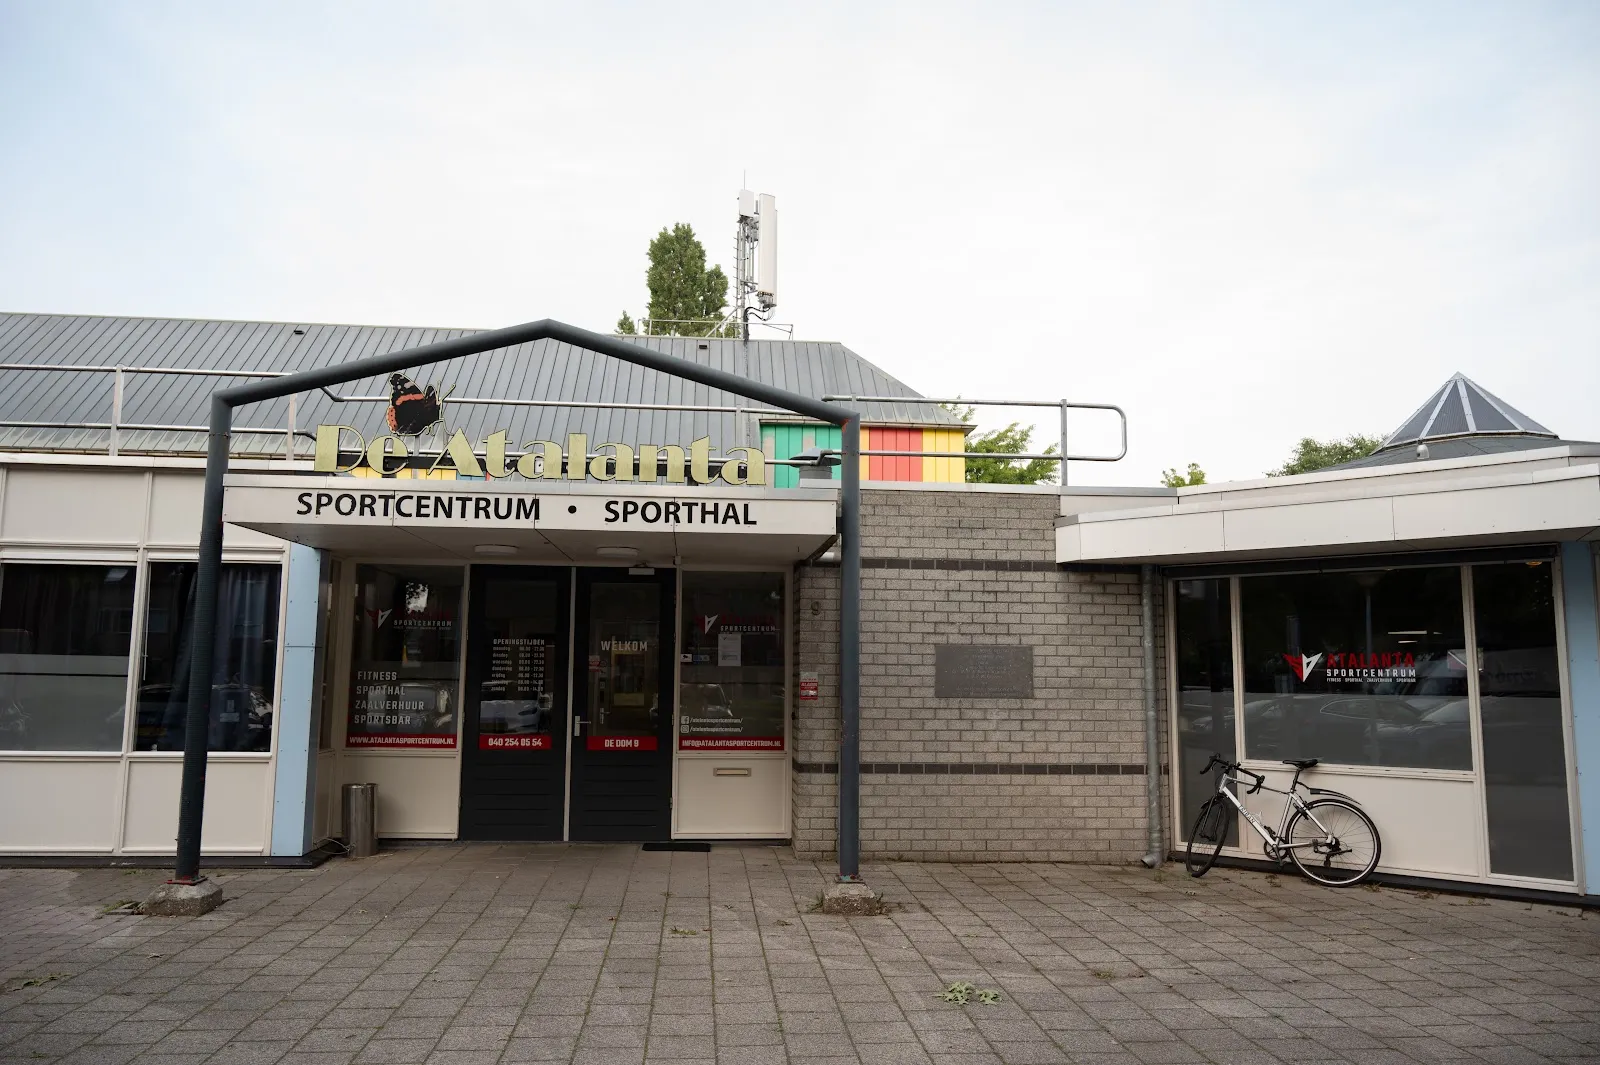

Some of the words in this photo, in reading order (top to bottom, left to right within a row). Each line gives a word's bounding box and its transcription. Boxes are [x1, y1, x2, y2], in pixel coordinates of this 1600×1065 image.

[313, 423, 409, 475] De
[427, 427, 767, 486] Atalanta
[296, 492, 541, 520] SPORTCENTRUM
[604, 499, 758, 525] SPORTHAL
[811, 601, 820, 616] 9
[393, 619, 452, 627] SPORTCENTRUM
[600, 640, 648, 651] WELKOM
[1326, 652, 1416, 668] ATALANTA
[357, 671, 398, 681] FITNESS
[1326, 668, 1416, 677] SPORTCENTRUM
[356, 685, 406, 696] SPORTHAL
[355, 700, 425, 711] ZAALVERHUUR
[354, 714, 412, 725] SPORTSBAR
[349, 736, 455, 745] WWW.ATALANTASPORTCENTRUM.NL
[488, 737, 504, 746] 040
[504, 737, 519, 746] 254
[521, 738, 531, 746] 05
[532, 738, 543, 746] 54
[604, 739, 615, 748] DE
[615, 739, 633, 748] DOM
[633, 740, 640, 748] 9
[681, 739, 782, 748] INFO@ATALANTASPORTCENTRUM.NL
